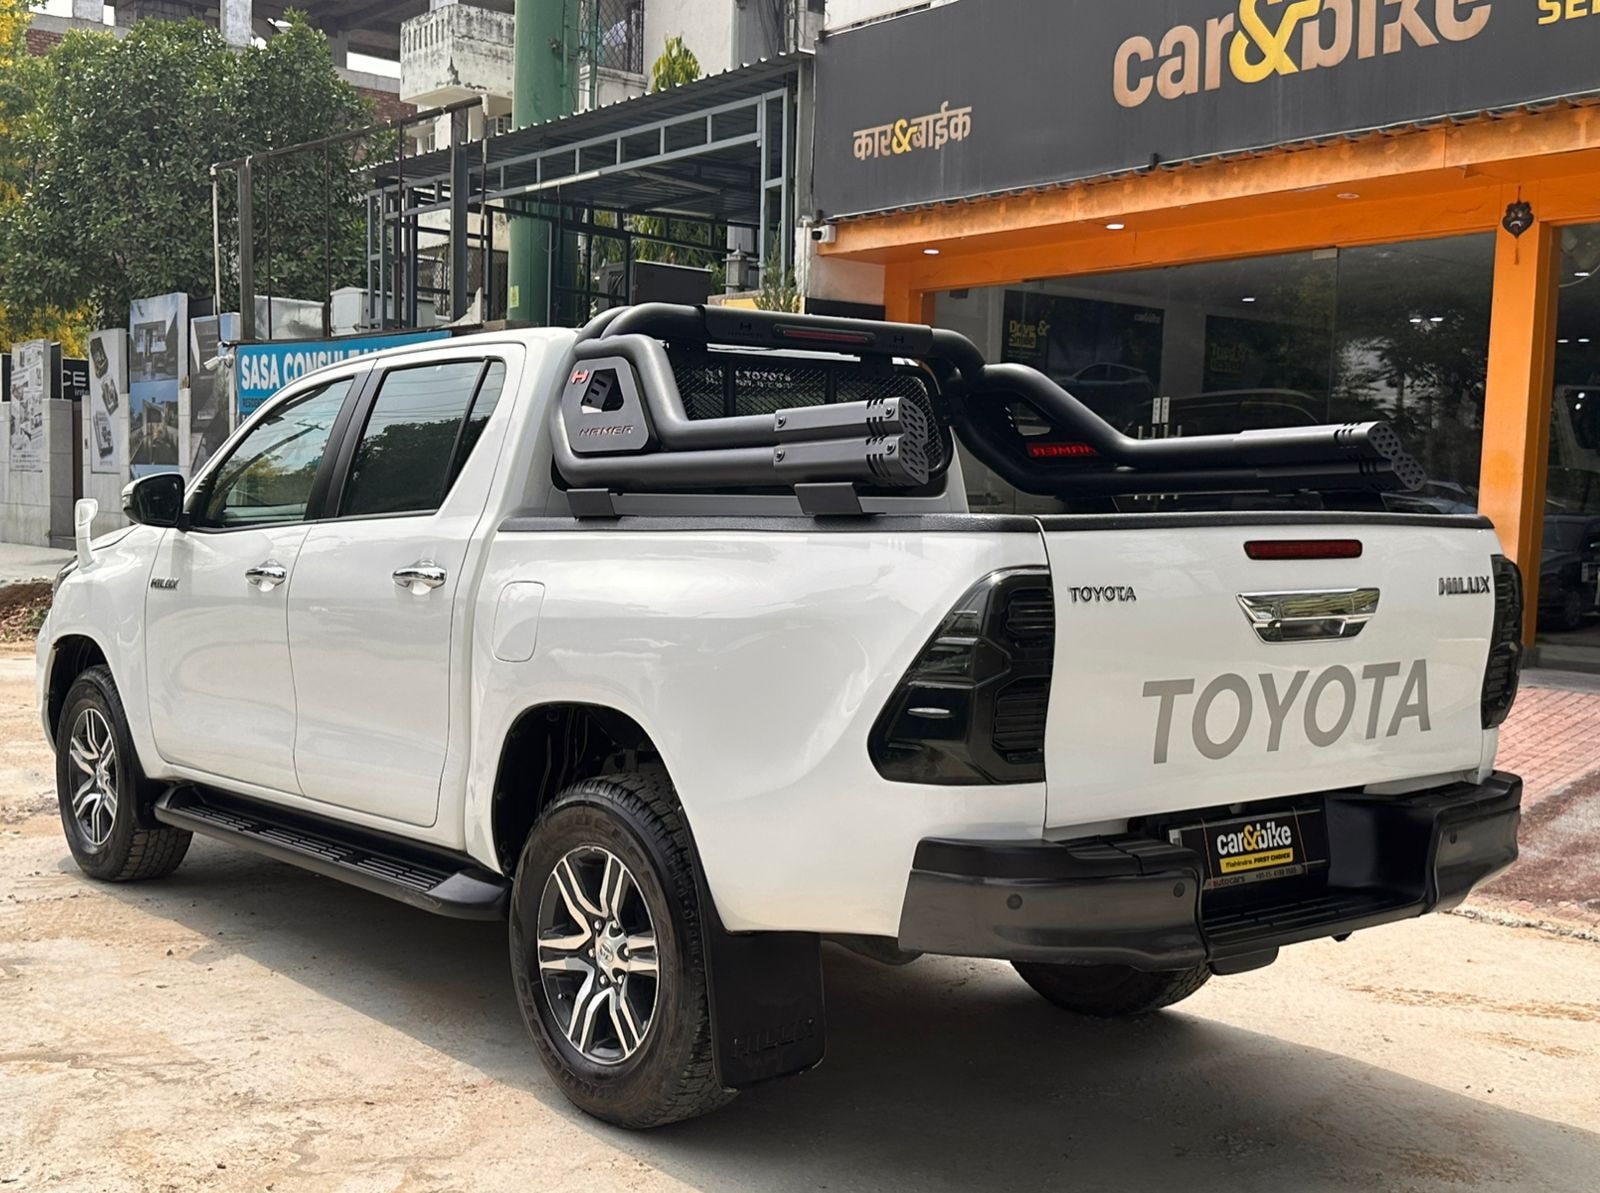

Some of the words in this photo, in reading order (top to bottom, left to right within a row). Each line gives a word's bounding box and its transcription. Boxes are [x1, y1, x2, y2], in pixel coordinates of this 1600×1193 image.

[853, 100, 972, 160] कार&बाईक
[241, 353, 280, 390] SASA
[1067, 586, 1137, 603] TOYOTA
[1438, 575, 1490, 595] HILUX
[1142, 659, 1431, 764] TOYOTA
[1216, 821, 1292, 855] car&bike
